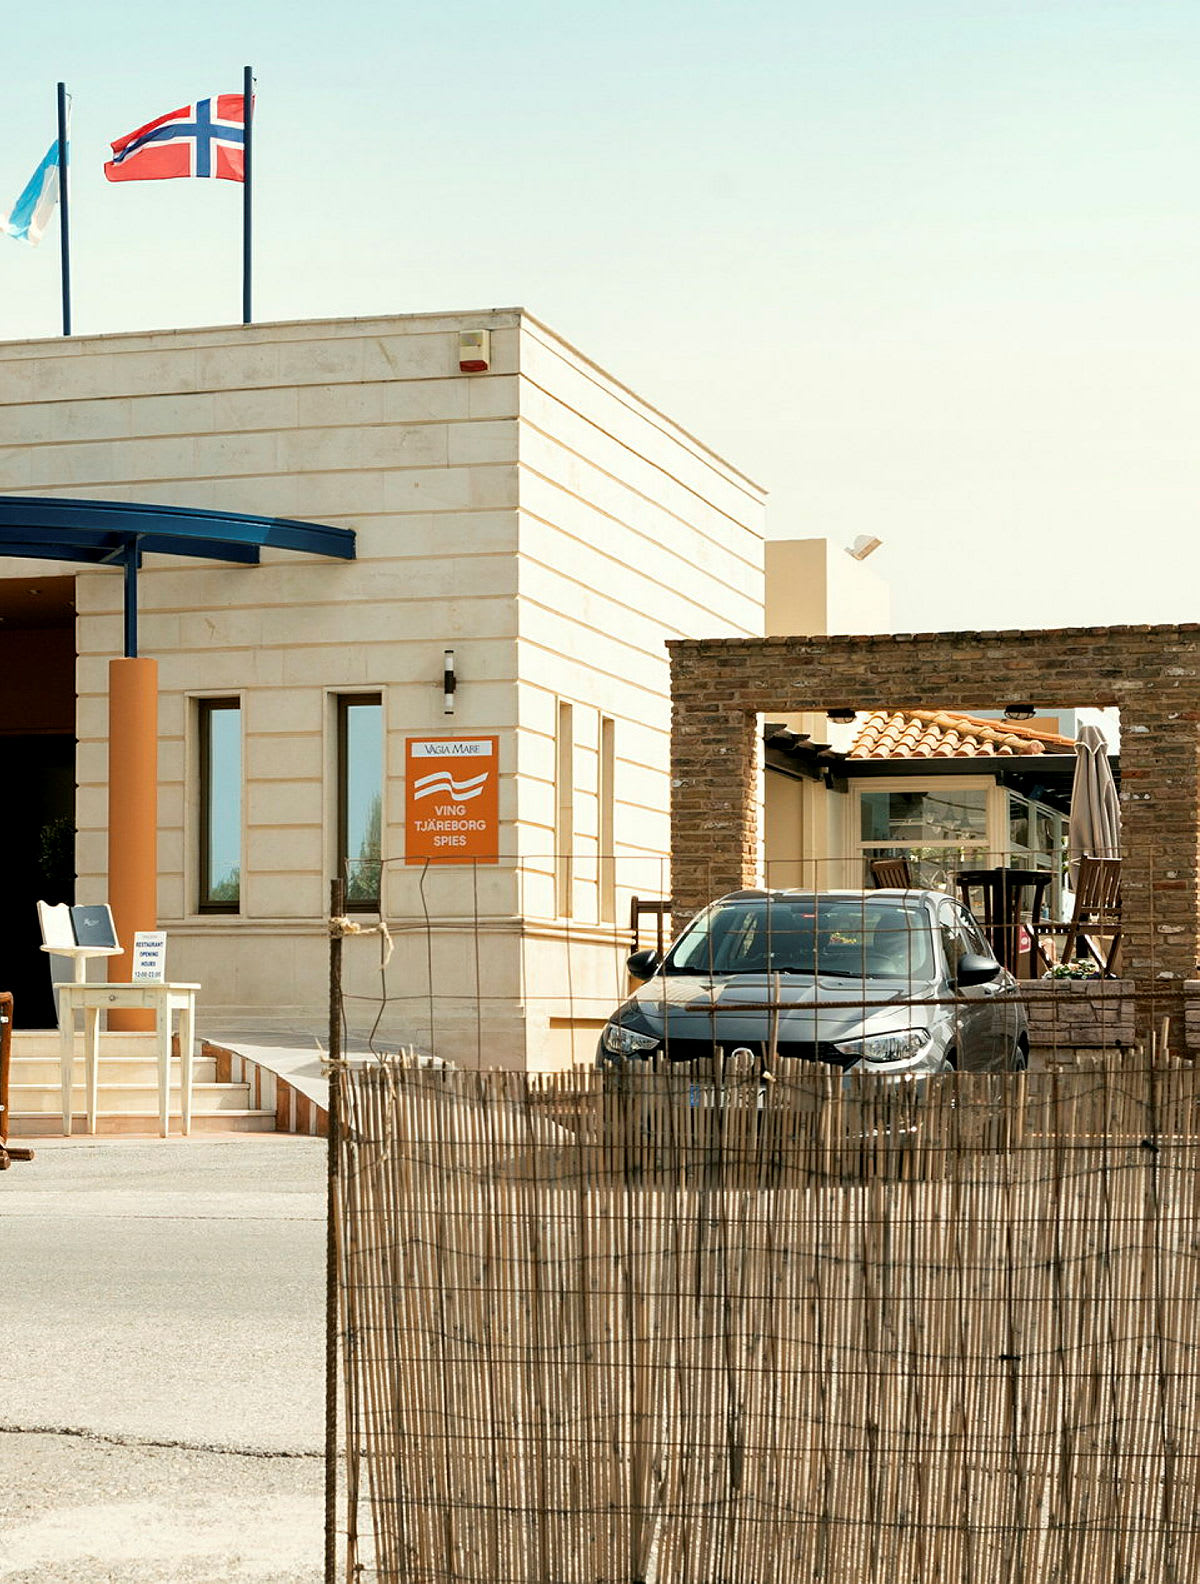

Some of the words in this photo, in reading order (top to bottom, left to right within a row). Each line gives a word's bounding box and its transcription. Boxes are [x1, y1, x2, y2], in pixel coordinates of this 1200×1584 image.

[452, 743, 480, 754] MARE
[434, 805, 467, 816] VING
[414, 818, 486, 831] TJÄREBORG
[433, 835, 467, 847] SPIES
